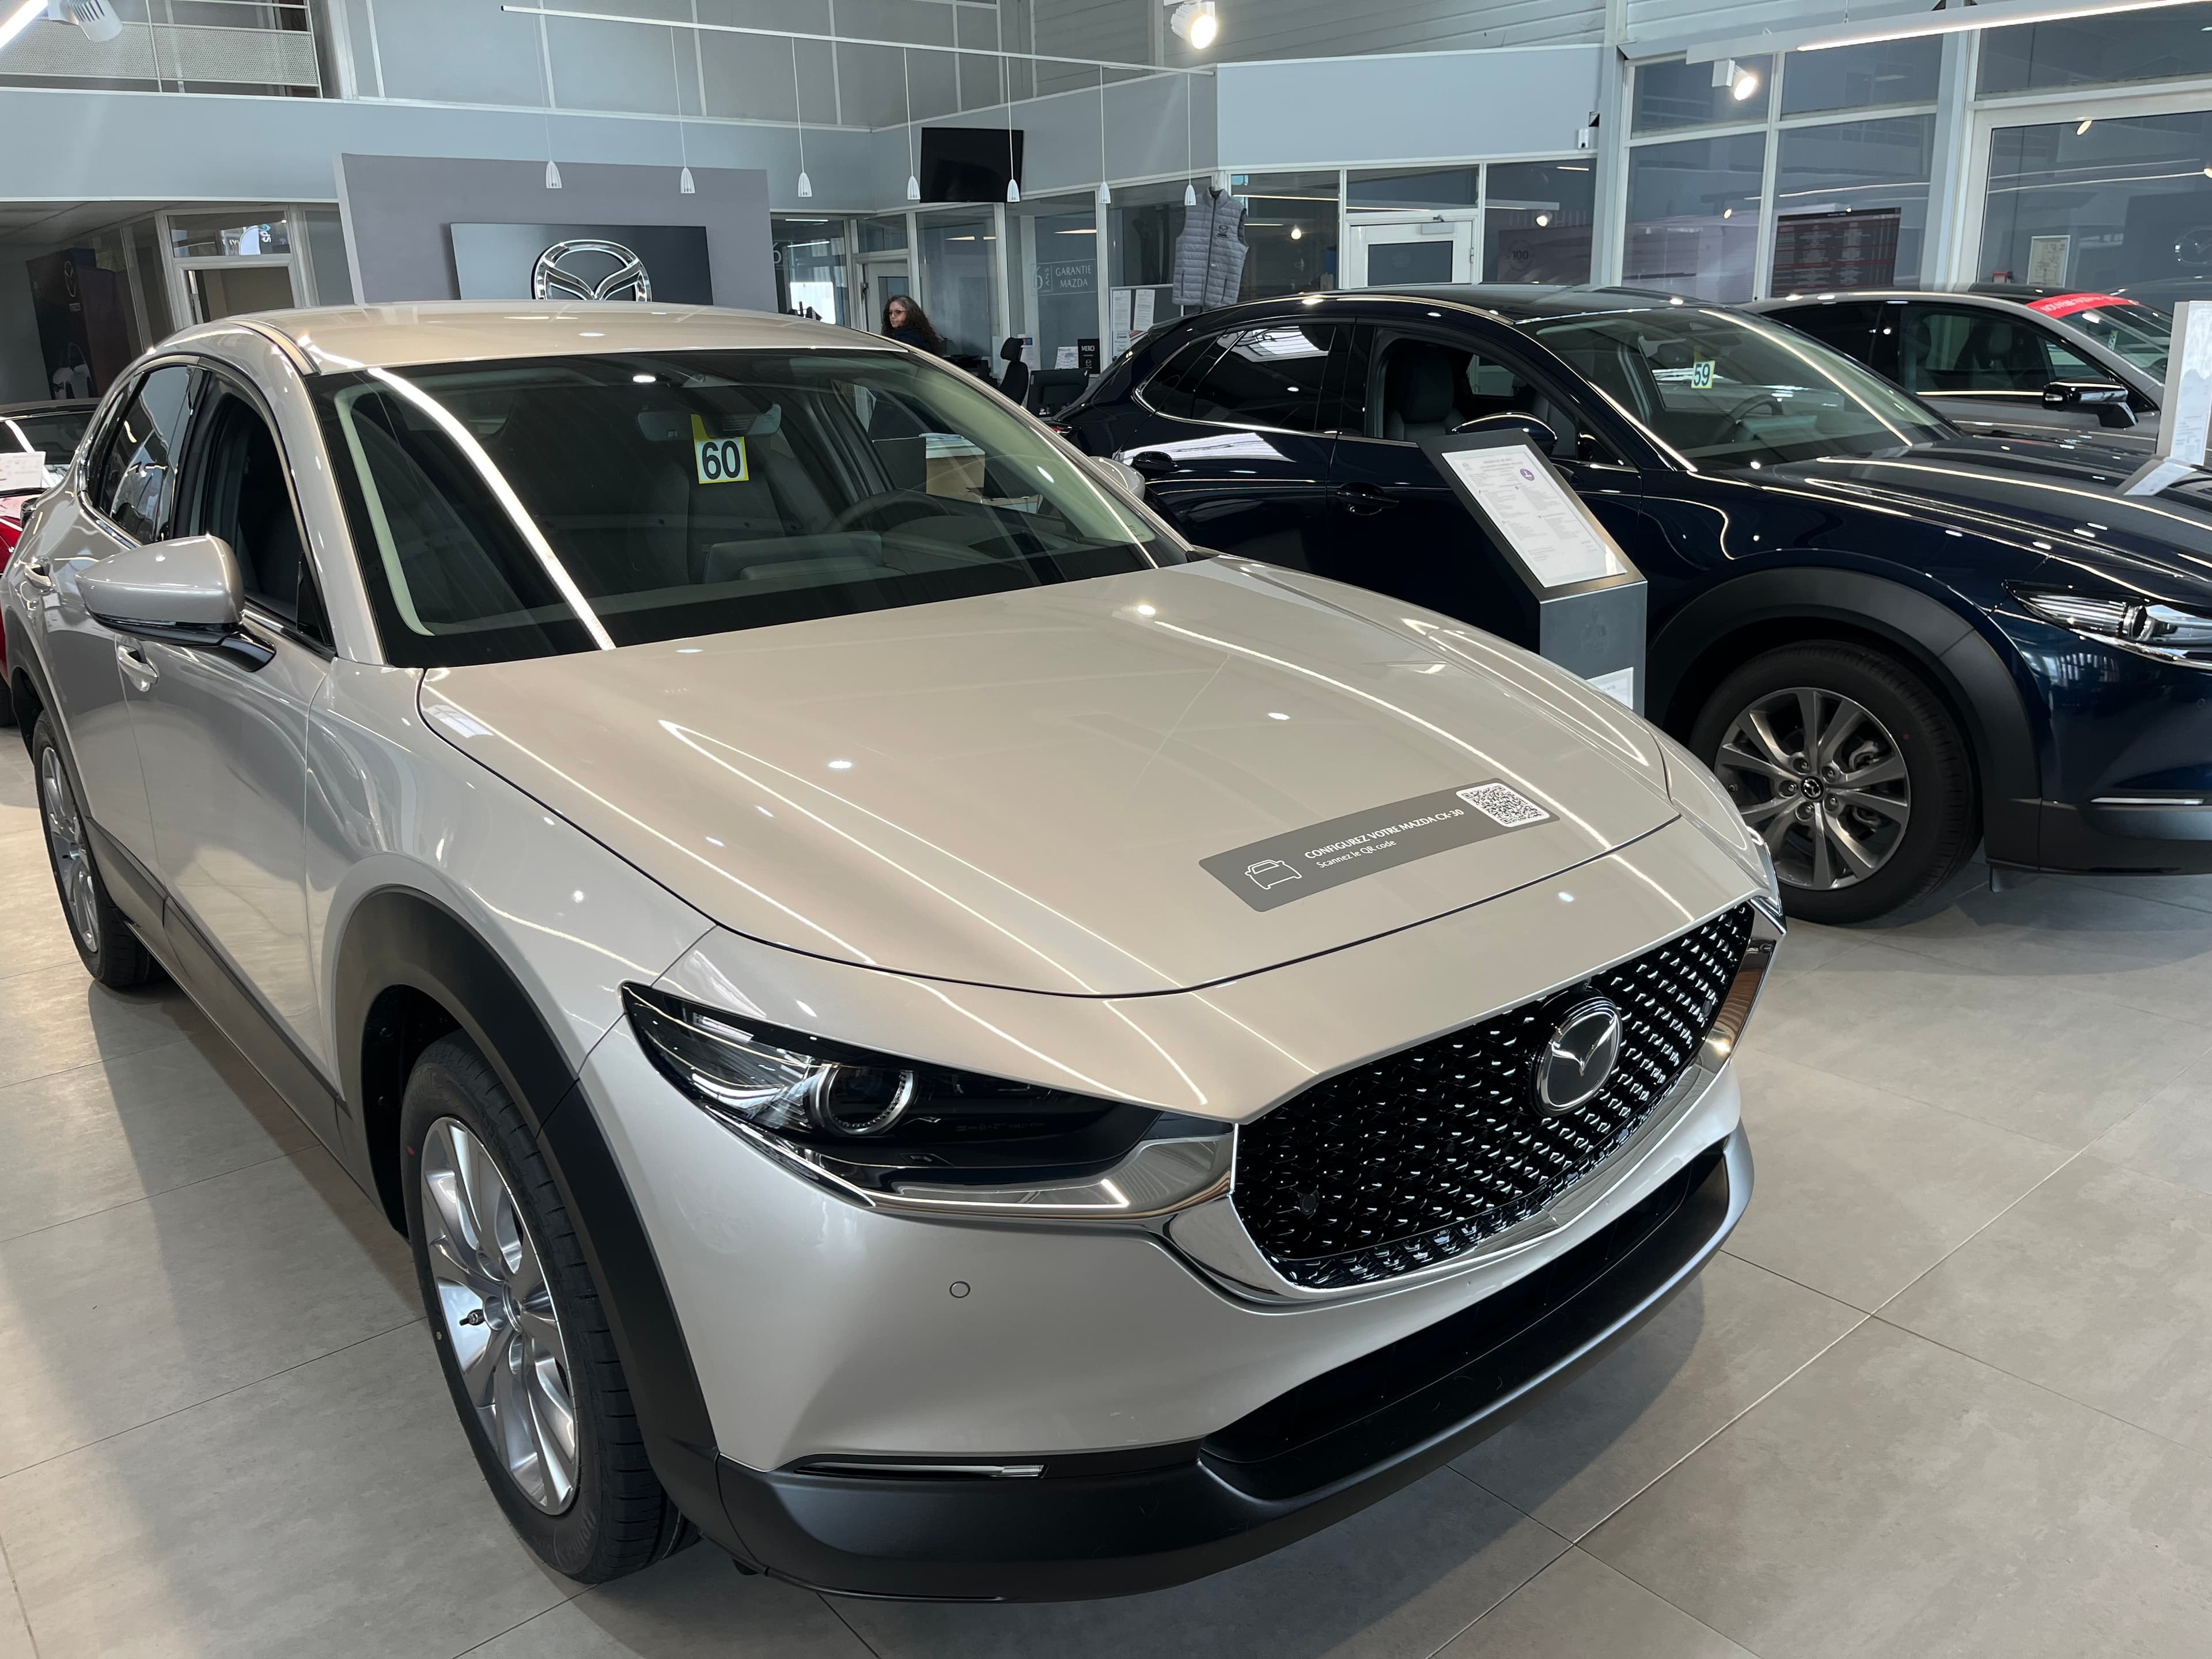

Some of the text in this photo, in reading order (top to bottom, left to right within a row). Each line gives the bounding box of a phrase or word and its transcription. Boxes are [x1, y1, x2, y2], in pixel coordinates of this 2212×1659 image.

[1513, 251, 1529, 260] 100
[1055, 265, 1092, 276] GARANTIE
[1060, 278, 1088, 288] MAZDA
[1694, 363, 1710, 387] 59
[702, 441, 741, 480] 60
[1304, 809, 1465, 859] CONFIGUREZ VOTRE MAZDA CX-30
[1316, 854, 1354, 868] Scannez
[1359, 846, 1377, 854] QR
[1376, 840, 1397, 850] code
